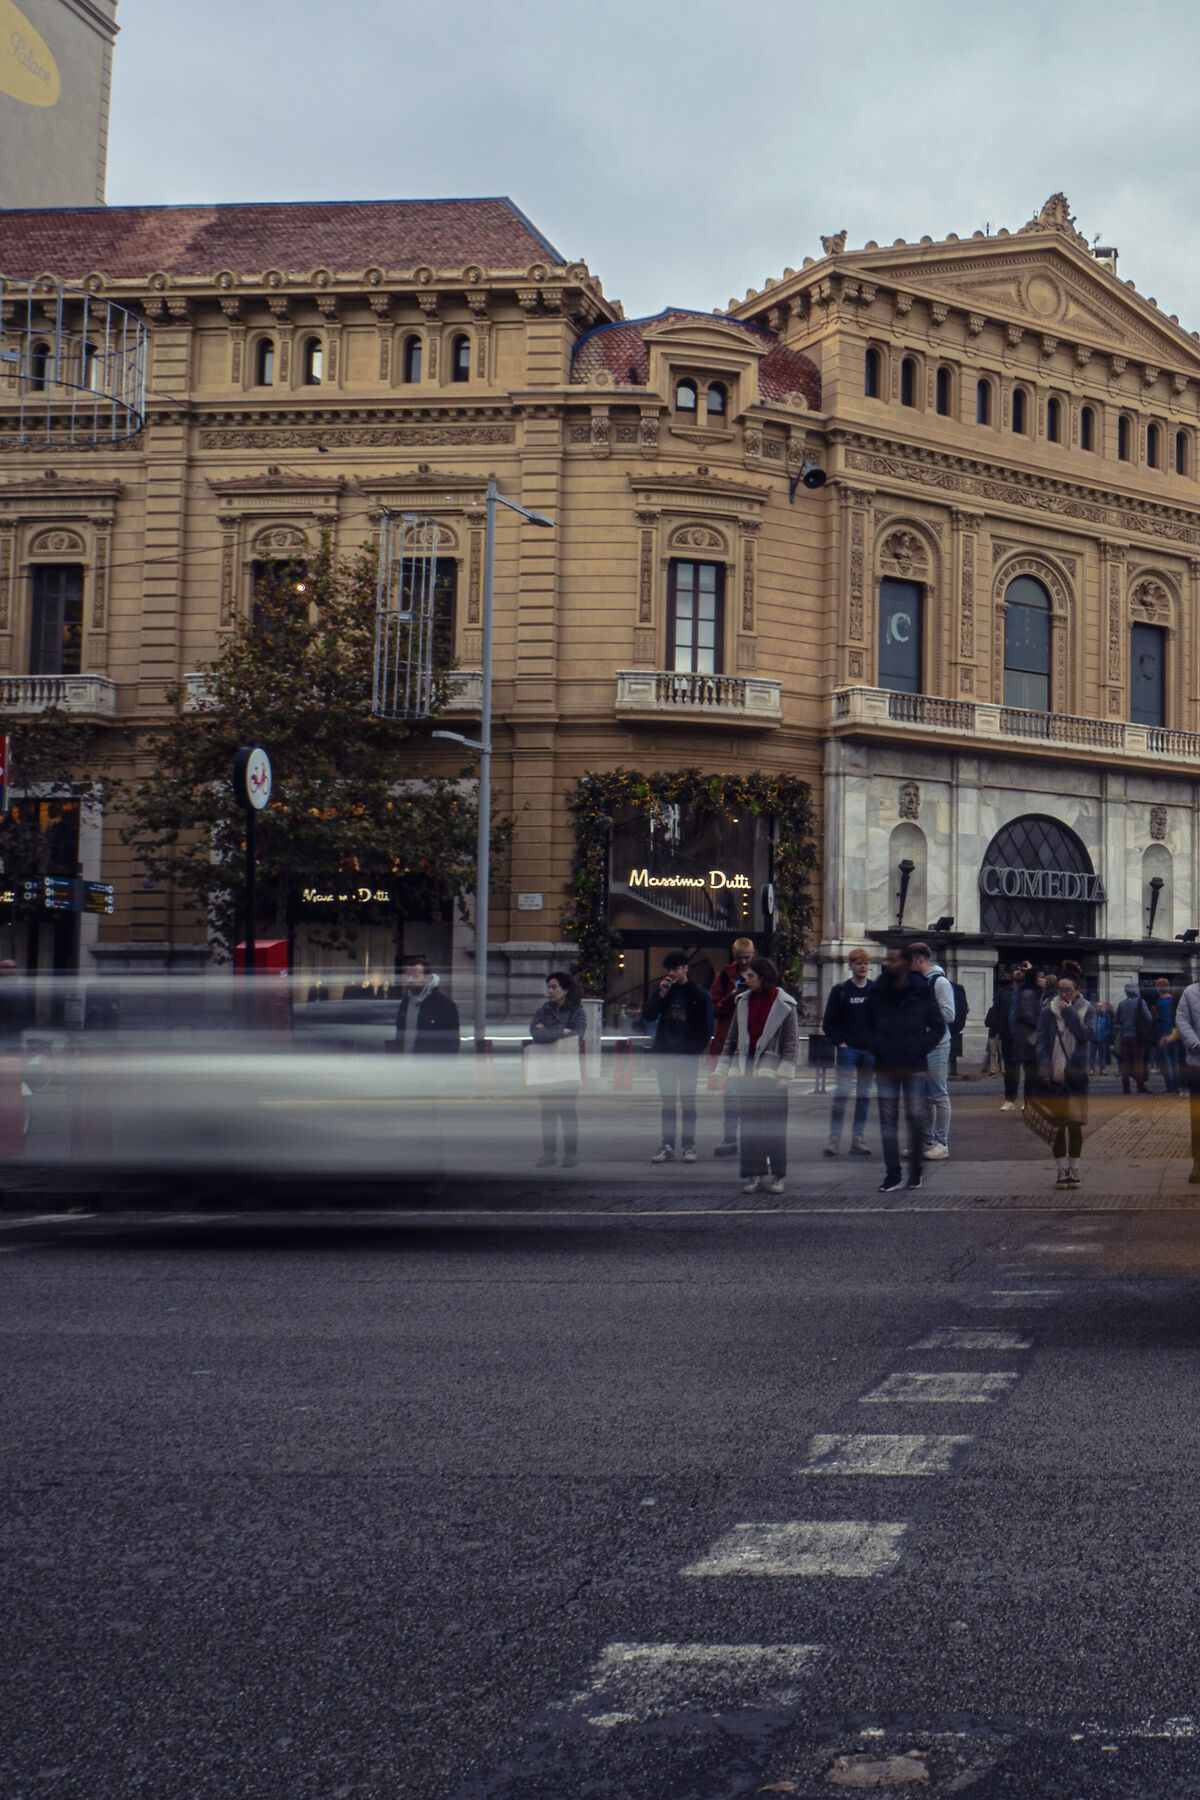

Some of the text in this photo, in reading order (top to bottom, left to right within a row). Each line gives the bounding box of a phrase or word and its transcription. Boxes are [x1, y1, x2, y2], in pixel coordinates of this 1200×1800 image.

[629, 869, 751, 889] Massimo Dutti
[978, 866, 1107, 902] COMEDIA
